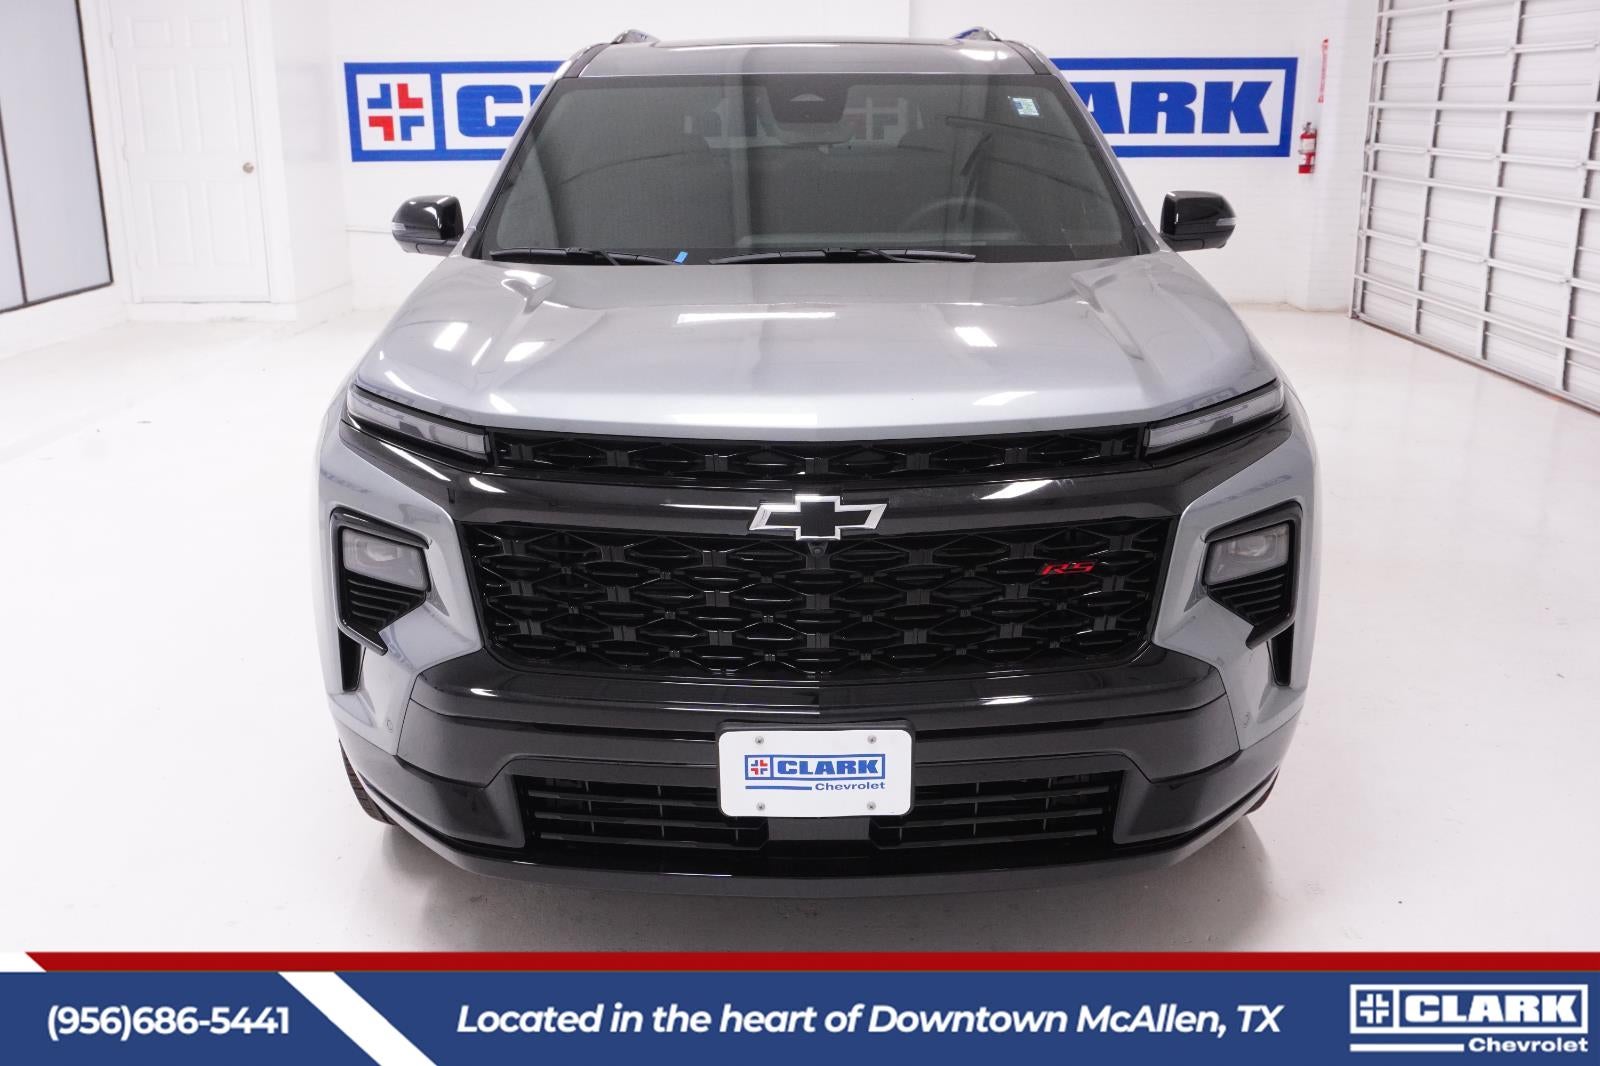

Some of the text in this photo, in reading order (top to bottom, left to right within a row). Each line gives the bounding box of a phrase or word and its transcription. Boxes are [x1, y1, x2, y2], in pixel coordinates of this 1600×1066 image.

[1041, 561, 1095, 576] RS
[777, 759, 879, 776] CLARK
[814, 780, 886, 791] Chevrolet
